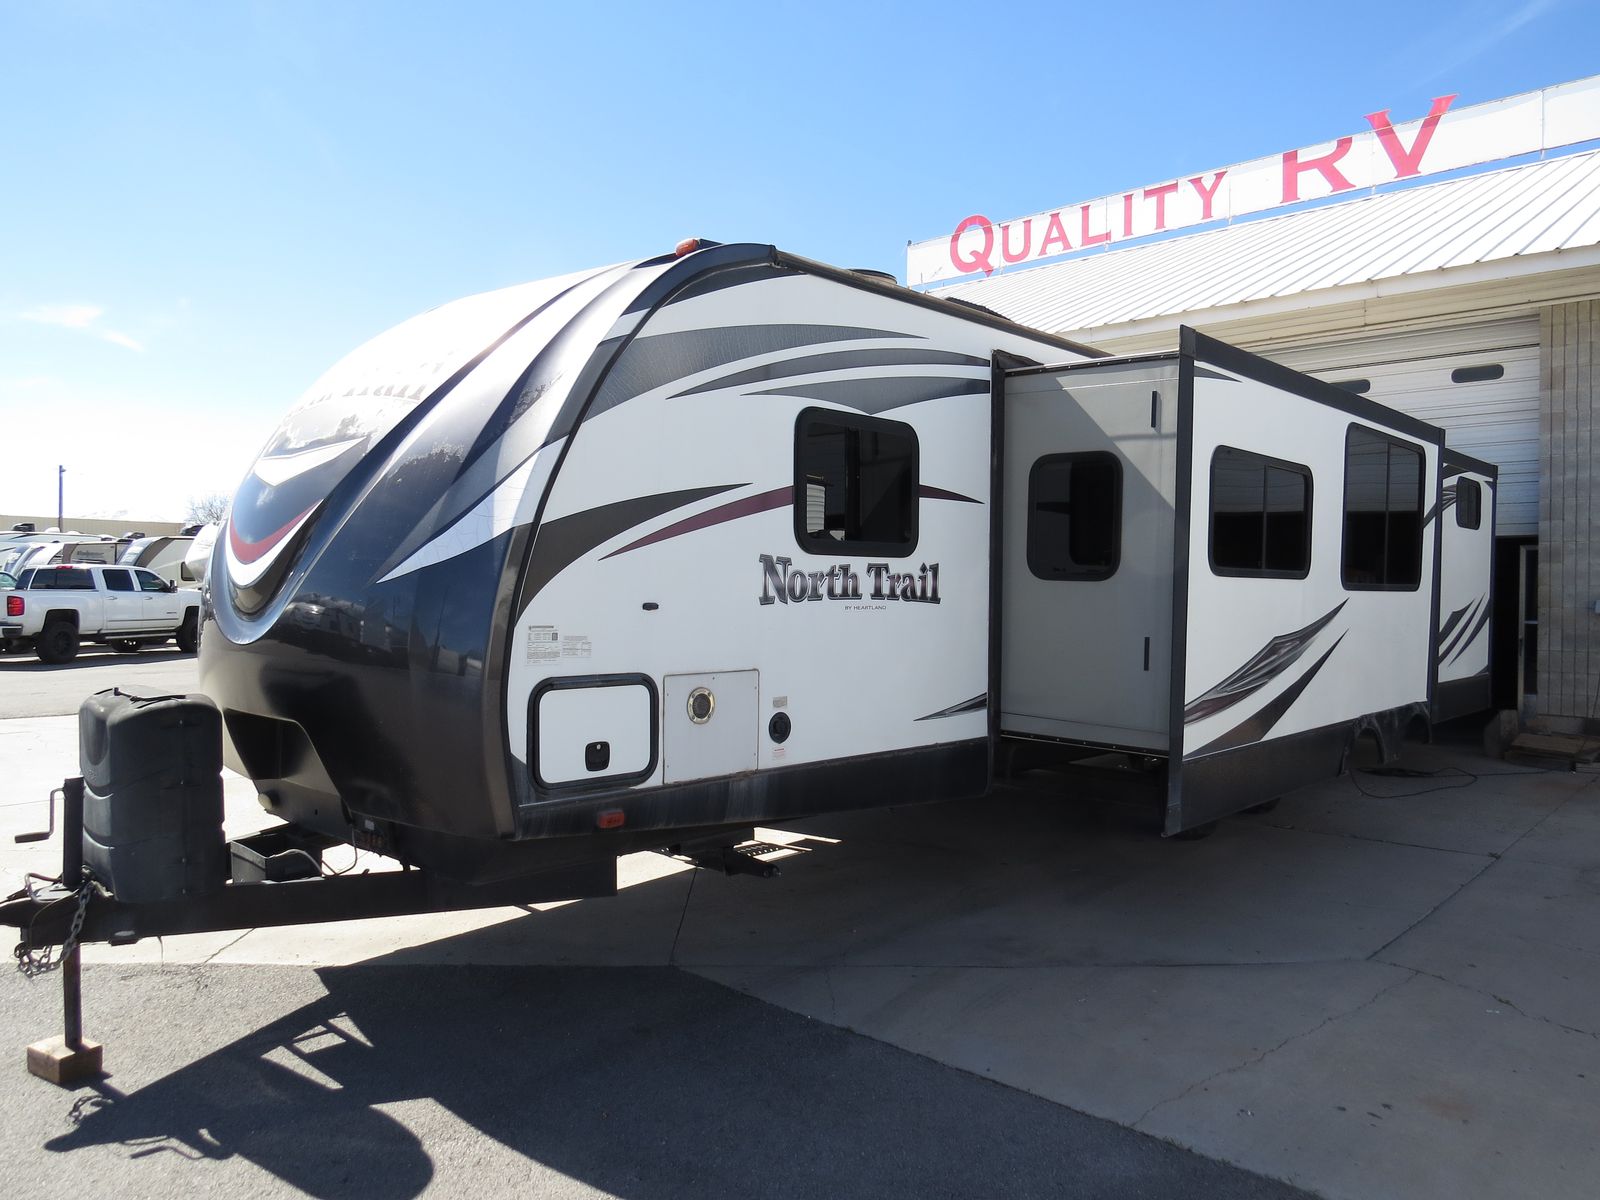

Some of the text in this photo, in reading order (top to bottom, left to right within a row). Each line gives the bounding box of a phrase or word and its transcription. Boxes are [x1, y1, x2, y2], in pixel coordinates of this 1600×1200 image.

[950, 93, 1459, 277] QUALITY RV
[758, 553, 942, 606] North Trail
